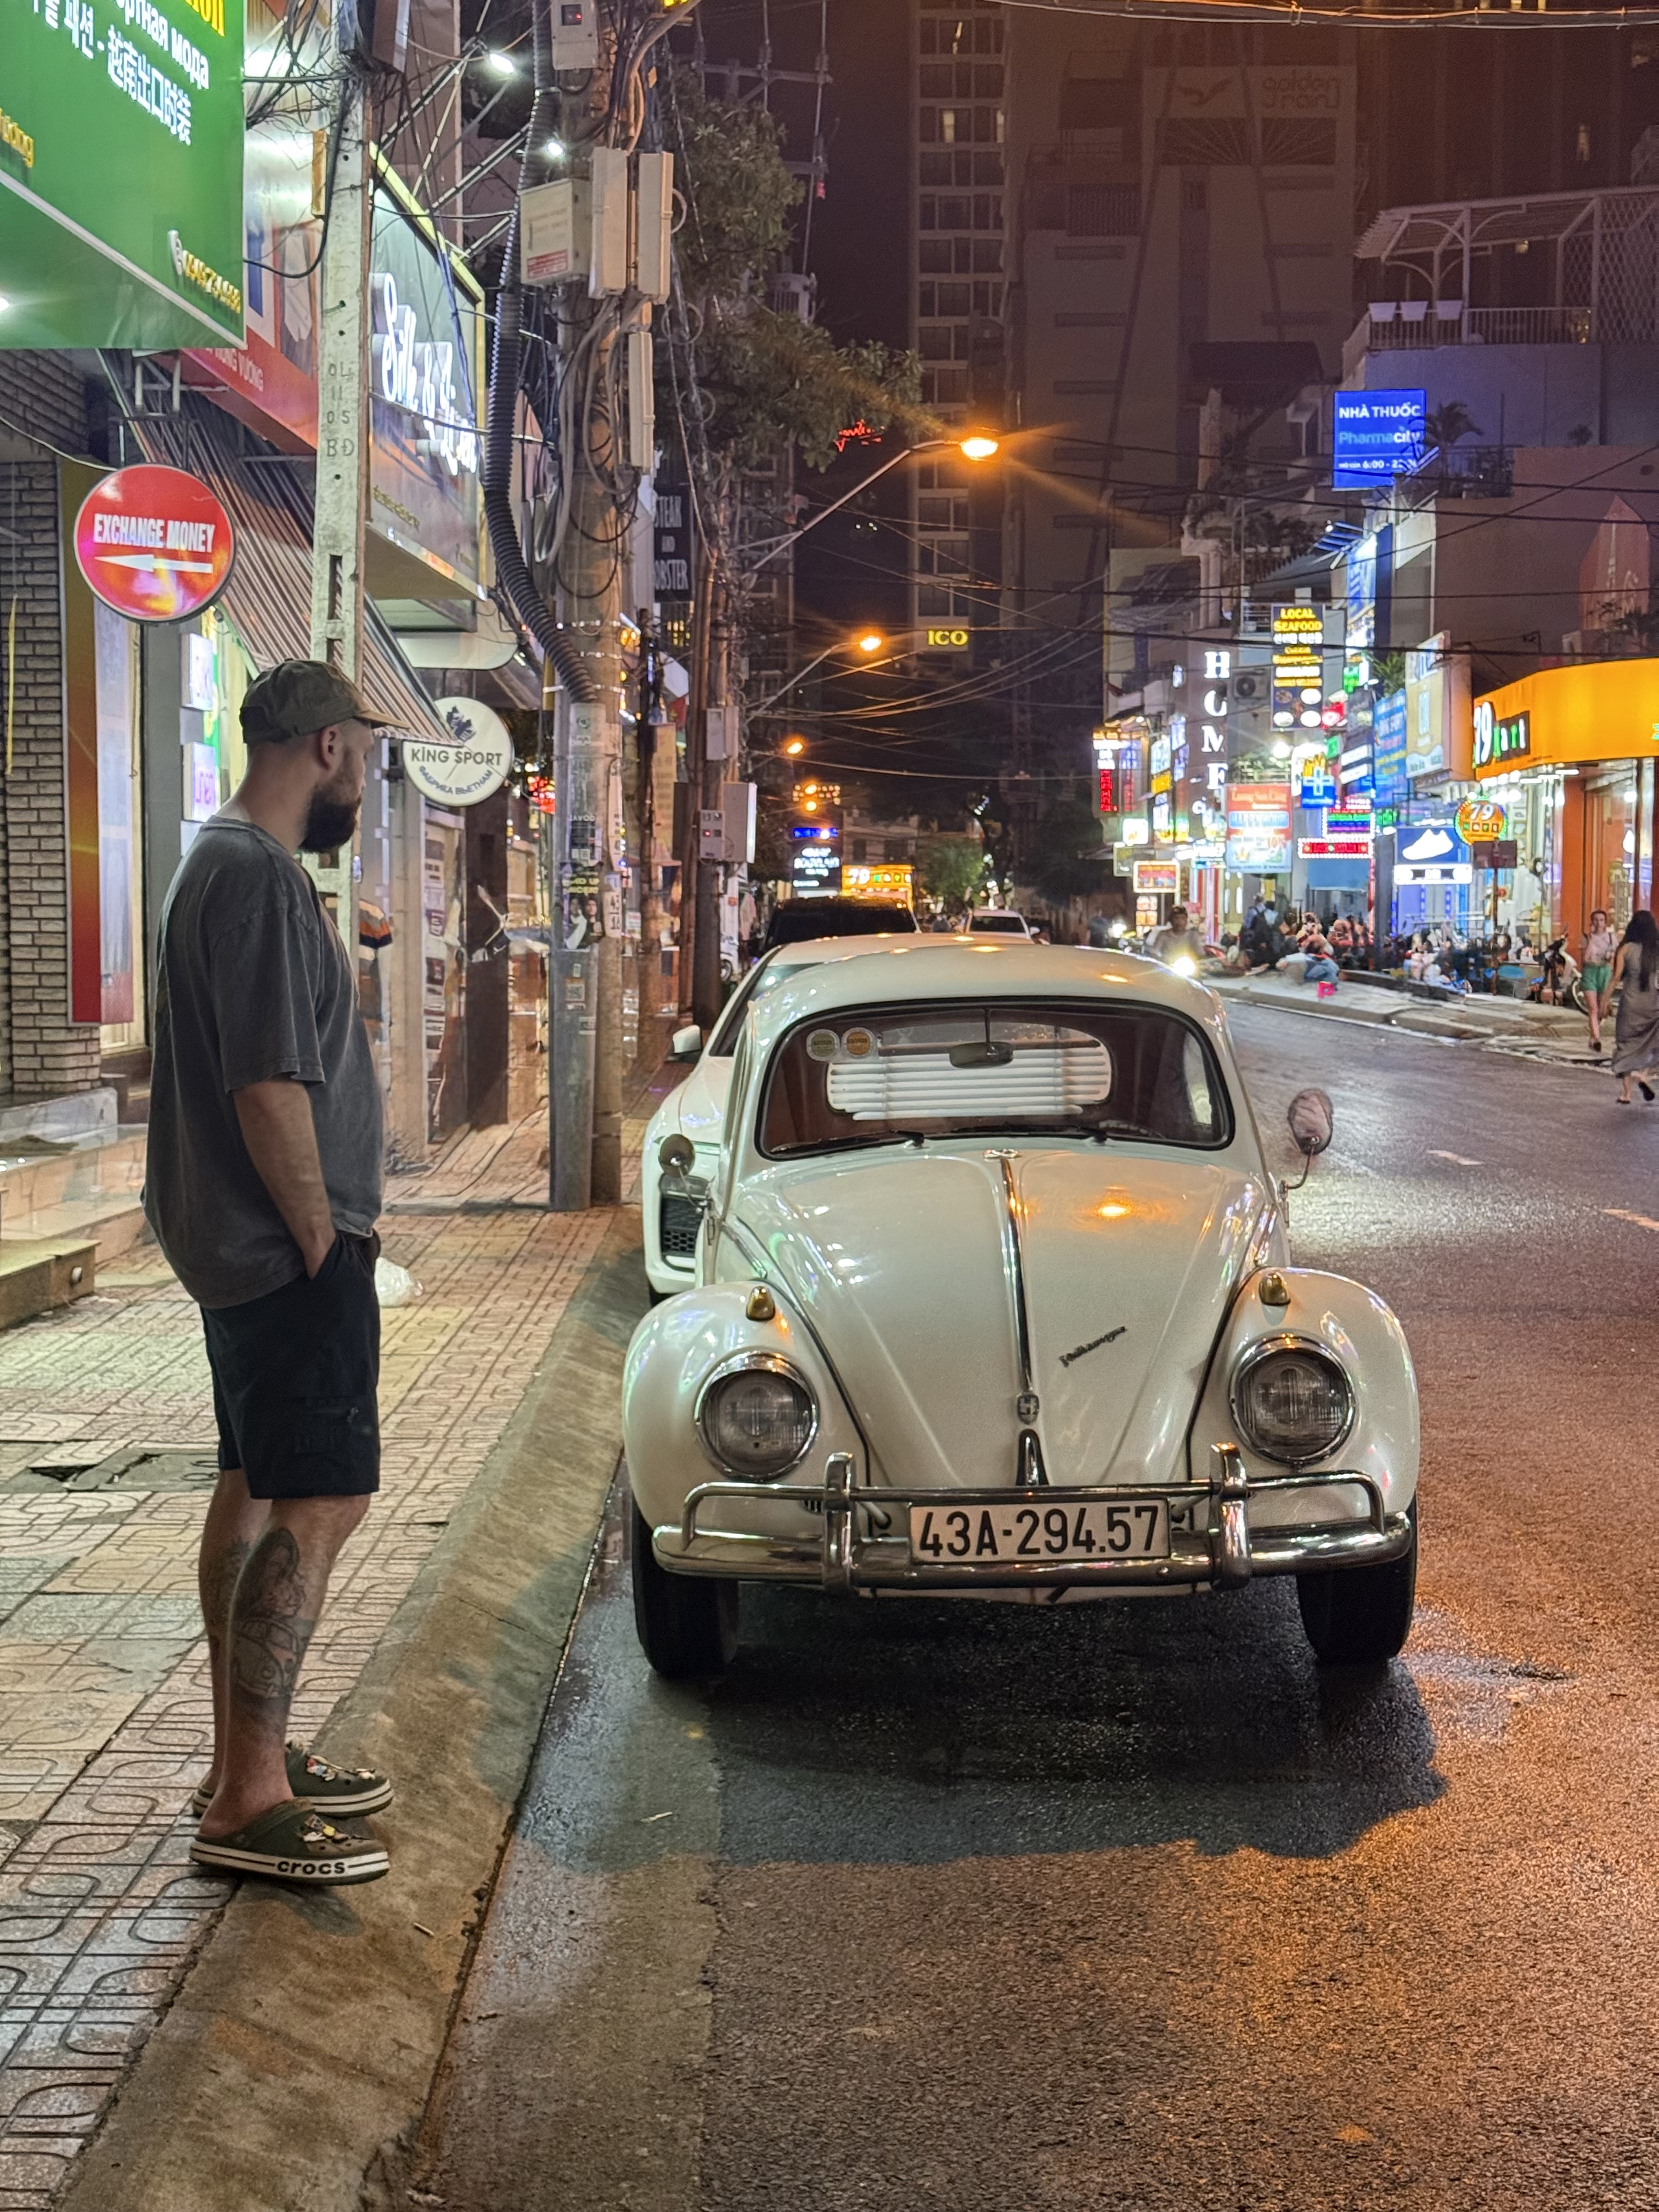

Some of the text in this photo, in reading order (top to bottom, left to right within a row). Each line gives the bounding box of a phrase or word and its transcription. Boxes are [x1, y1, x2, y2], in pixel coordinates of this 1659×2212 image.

[171, 27, 210, 90] мода
[1339, 402, 1421, 419] NHÀ THUỐC
[1362, 460, 1385, 469] 6:00
[94, 513, 215, 553] EXCHANGE MONEY
[654, 558, 690, 590] OBSTER
[1280, 608, 1317, 619] LOCAL
[1273, 620, 1323, 632] SEAFOOD
[928, 630, 968, 646] ICO
[454, 751, 503, 766] SPORT
[1470, 803, 1494, 820] 79
[919, 1505, 1159, 1557] 43A-294.57
[277, 1860, 346, 1875] crocs
